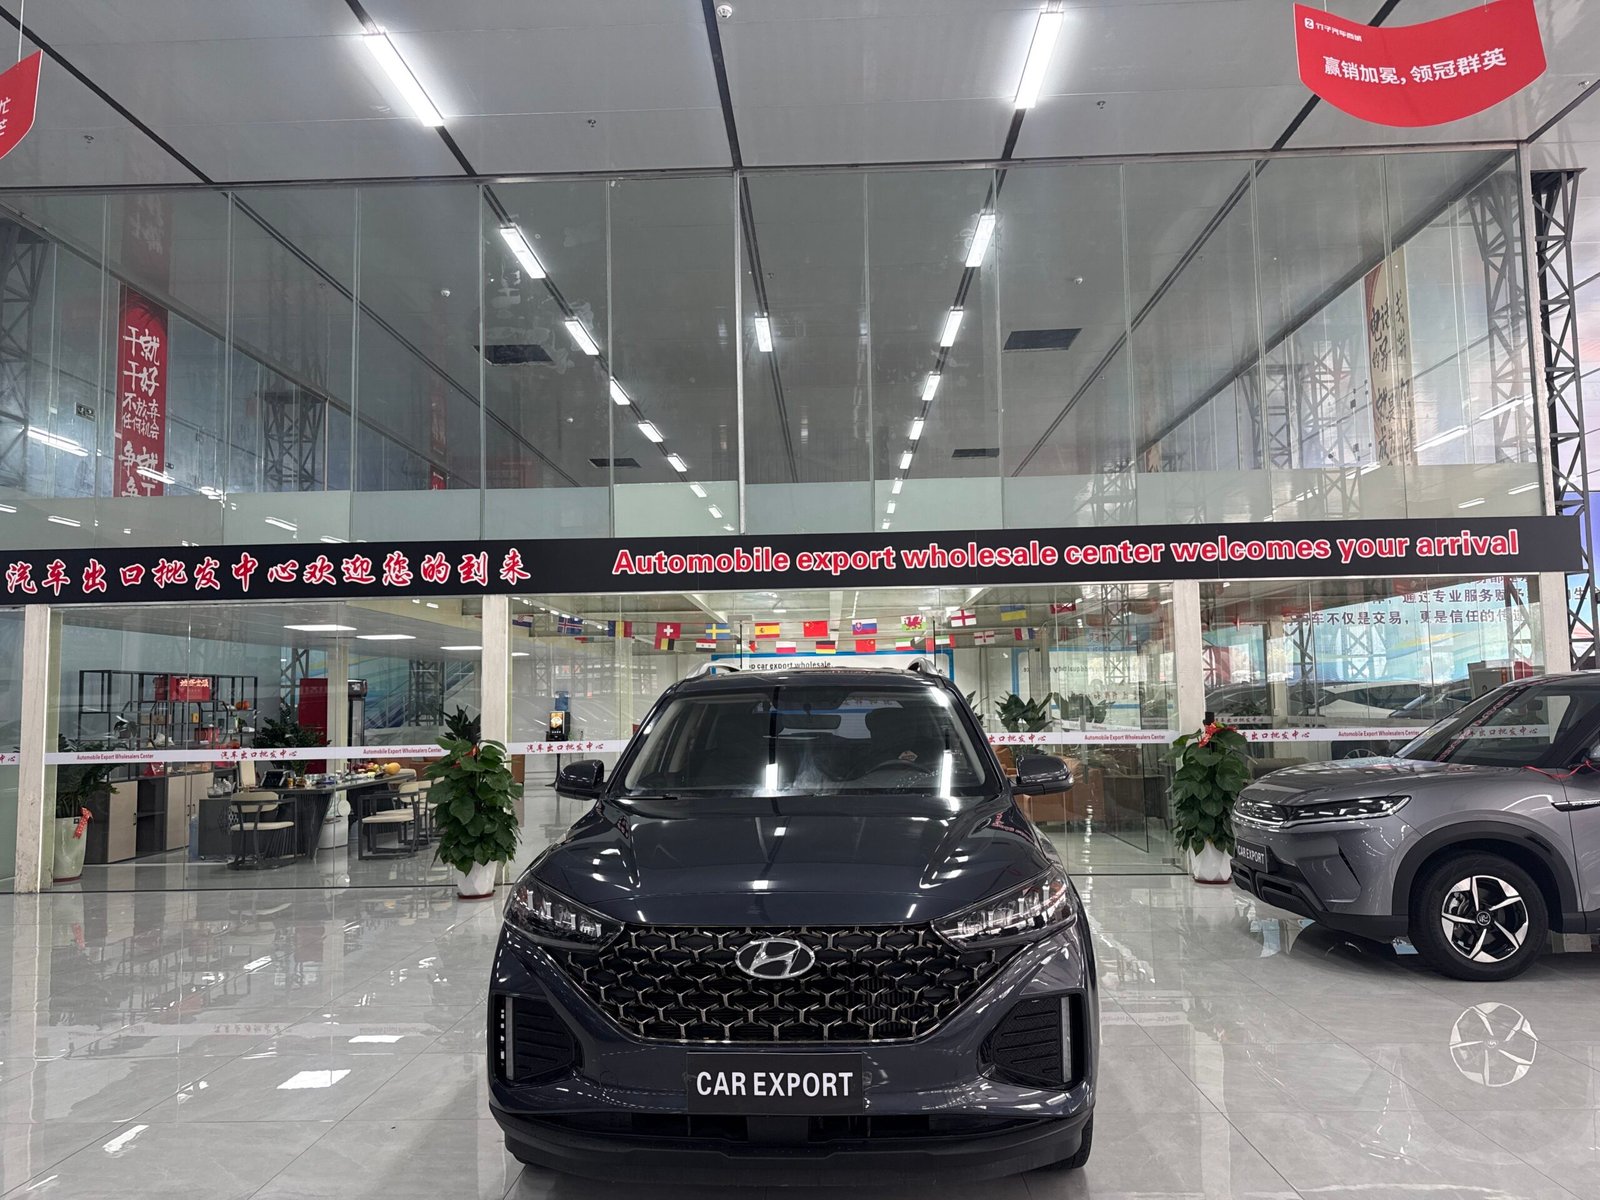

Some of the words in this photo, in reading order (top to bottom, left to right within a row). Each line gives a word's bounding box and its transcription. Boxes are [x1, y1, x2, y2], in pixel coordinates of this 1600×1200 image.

[1323, 48, 1507, 85] 赢销加冕，领冠群英
[612, 547, 791, 575] Automobile
[796, 545, 897, 576] export
[901, 541, 1059, 570] wholesale
[1065, 540, 1166, 566] center
[1170, 534, 1332, 562] welcomes
[1336, 536, 1409, 564] your
[1415, 528, 1519, 557] arrival
[6, 548, 532, 596] 汽车出口批发中心欢迎您的到来
[220, 750, 297, 759] 汽车出口批发中心
[526, 742, 604, 752] 汽车出口批发中心
[1237, 845, 1246, 857] CAR
[1246, 848, 1265, 864] EXPORT
[696, 1071, 746, 1096] CAR
[753, 1072, 853, 1097] EXPORT
